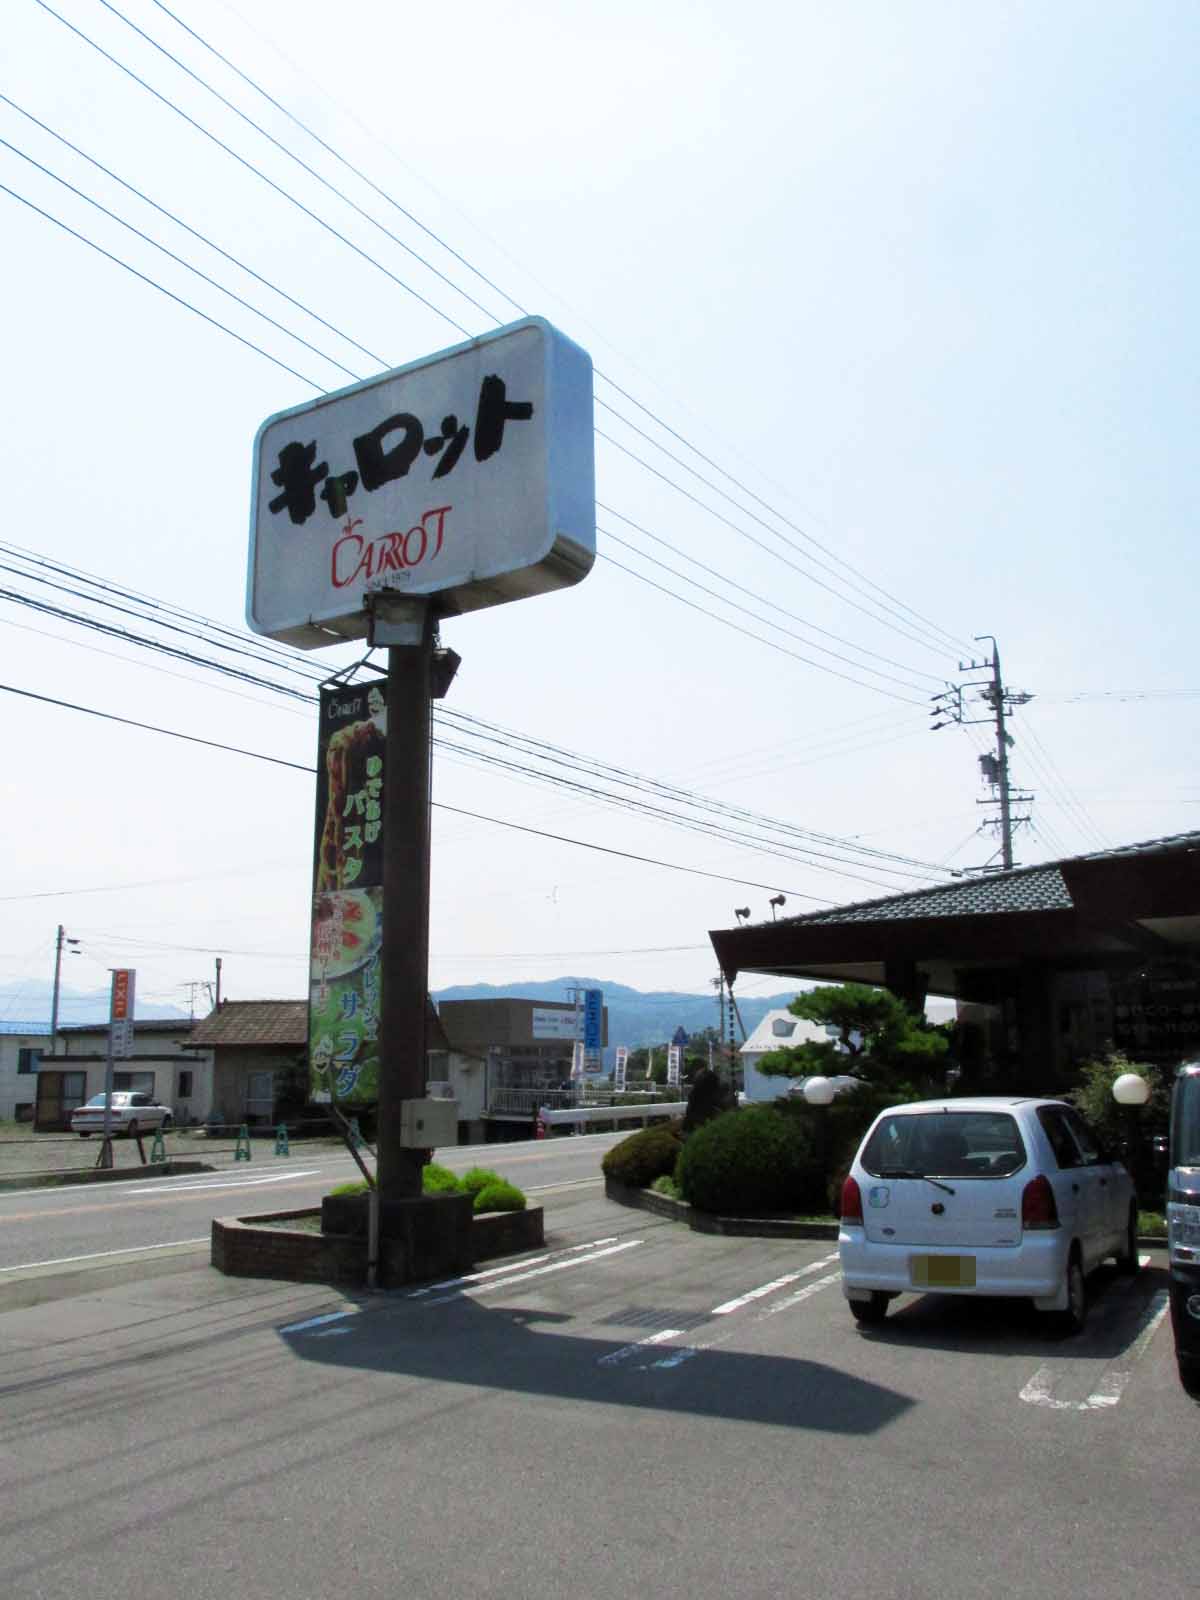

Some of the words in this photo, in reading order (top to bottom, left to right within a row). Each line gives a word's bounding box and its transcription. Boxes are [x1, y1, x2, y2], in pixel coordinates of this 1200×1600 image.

[269, 374, 533, 525] キャロット
[331, 506, 452, 588] CARROT
[335, 991, 360, 1096] サラダ
